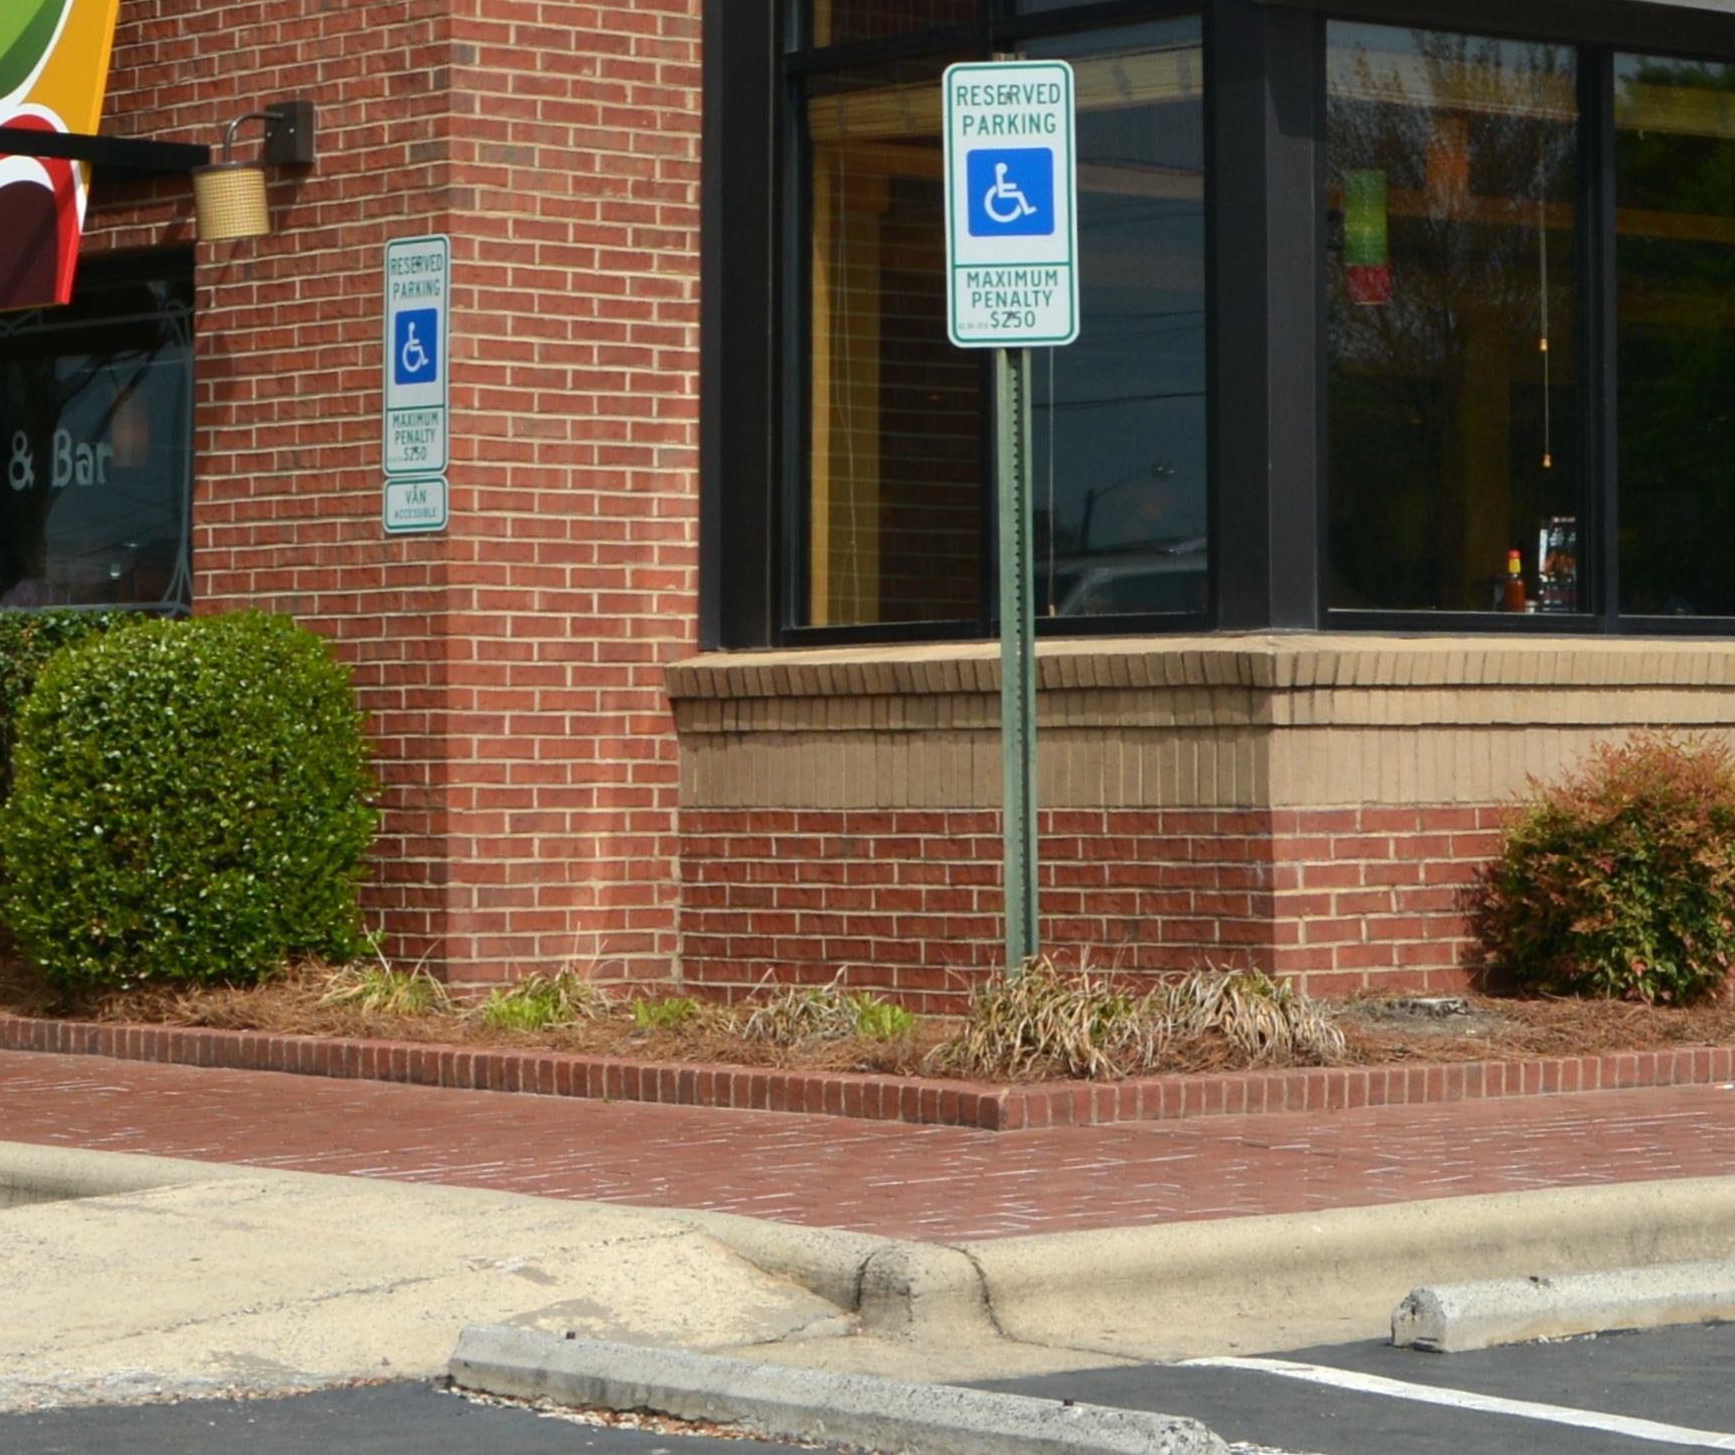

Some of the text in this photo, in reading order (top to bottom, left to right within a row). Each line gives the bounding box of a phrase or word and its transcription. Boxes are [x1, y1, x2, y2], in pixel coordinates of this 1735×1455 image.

[956, 82, 1061, 106] RESERVED
[962, 112, 1056, 136] PARKING
[391, 253, 442, 275] RESERVED
[967, 269, 1058, 288] MAXIMUM
[393, 278, 440, 300] PARKING
[971, 290, 1053, 308] PENALTY
[990, 310, 1036, 329] $250
[393, 411, 438, 428] MAXIMUM
[394, 428, 436, 445] PENALTY
[8, 429, 35, 490] &
[52, 427, 114, 487] Bar
[405, 490, 427, 505] VAN
